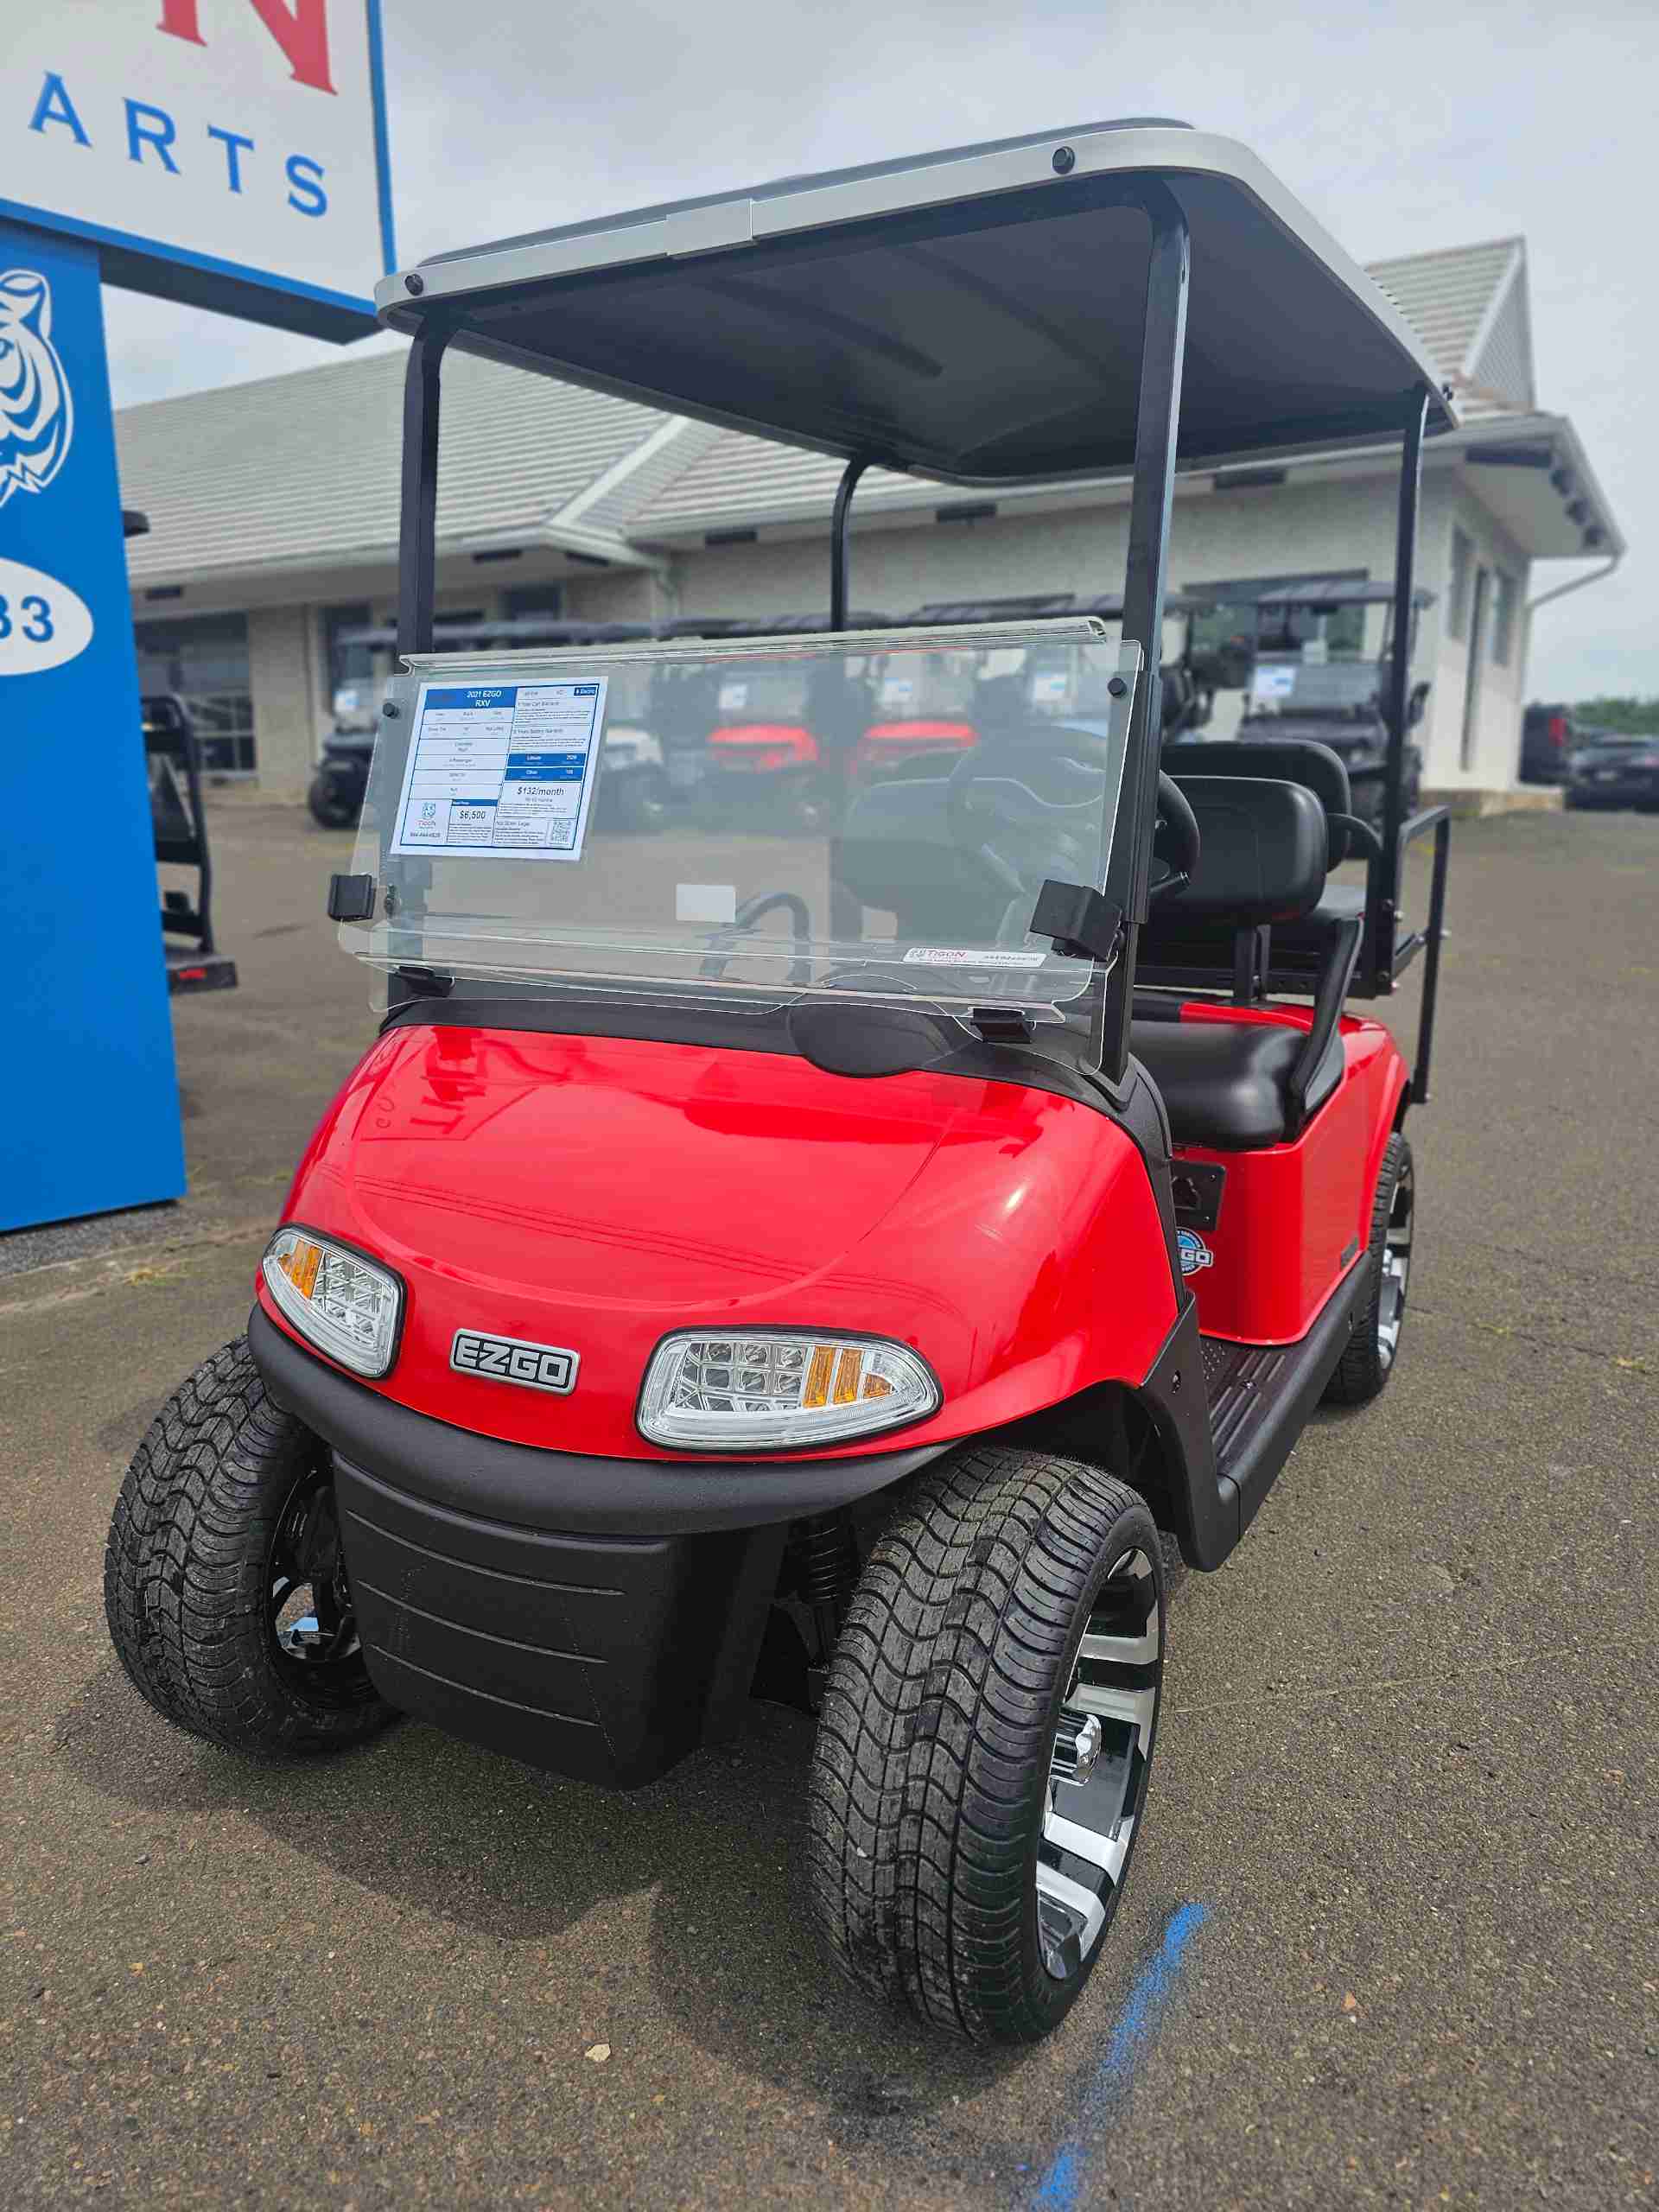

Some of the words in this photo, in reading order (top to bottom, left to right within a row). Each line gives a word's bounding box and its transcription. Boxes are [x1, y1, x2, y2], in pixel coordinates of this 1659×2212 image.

[29, 70, 328, 218] ARTS
[517, 786, 564, 796] $132/month
[459, 810, 486, 820] $6,500
[1180, 1248, 1211, 1264] GO
[454, 1337, 570, 1386] EZGO
